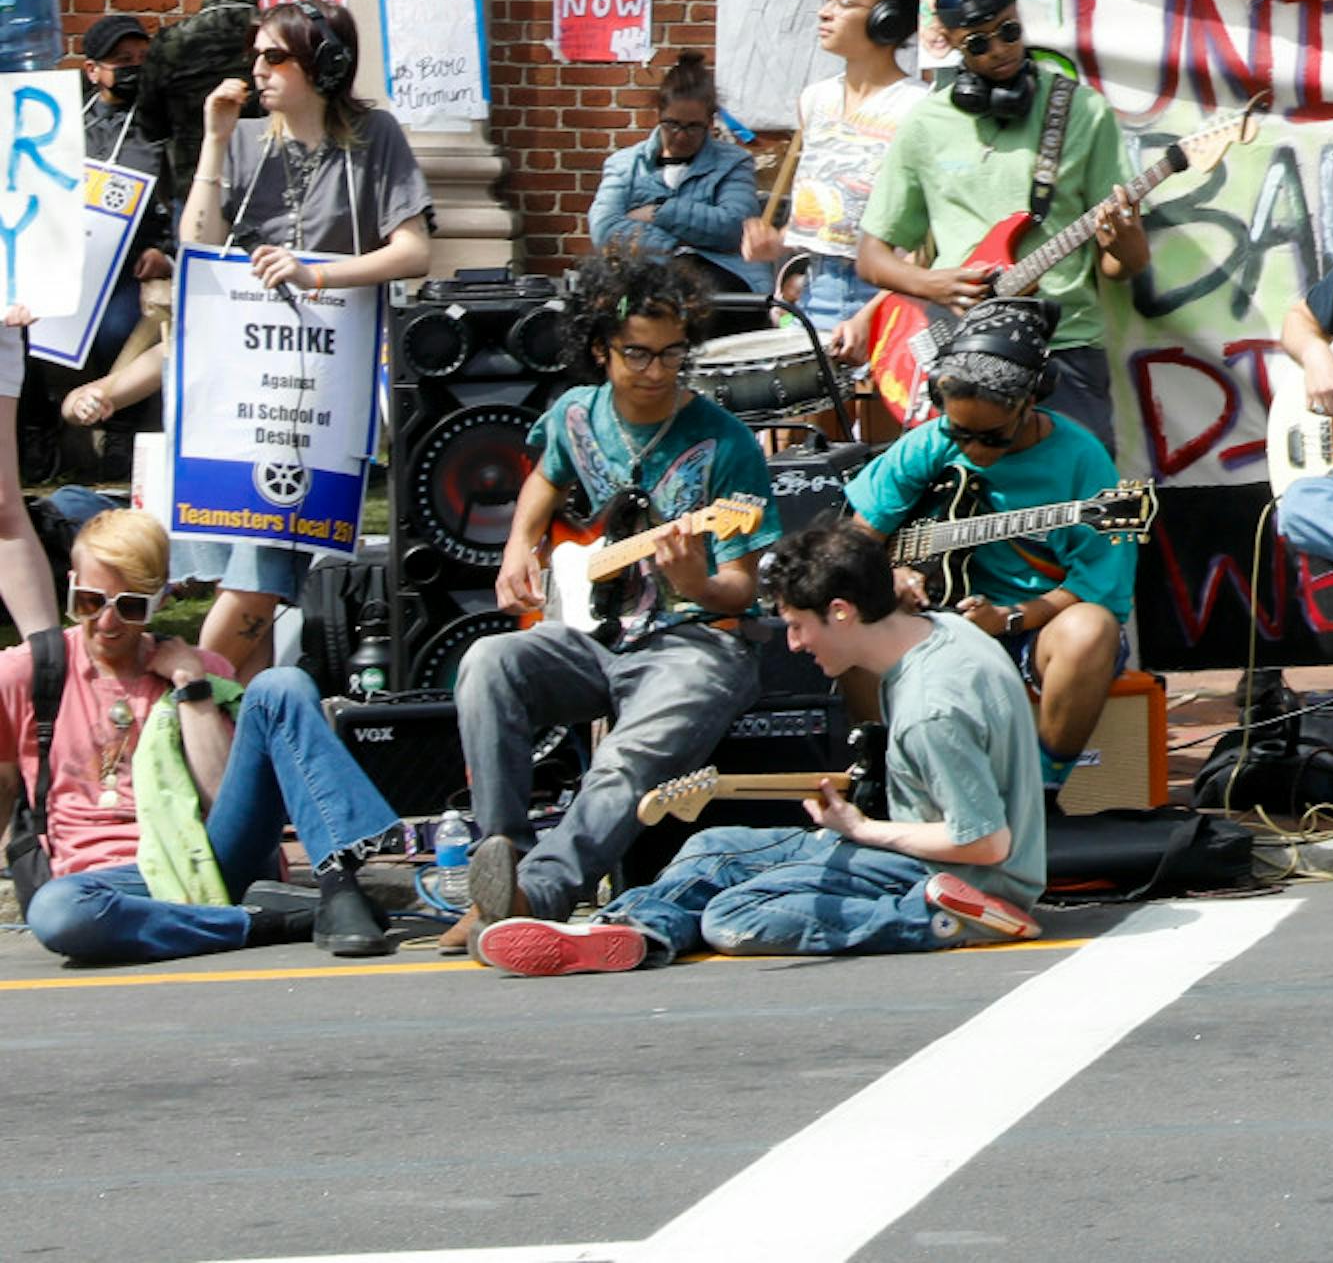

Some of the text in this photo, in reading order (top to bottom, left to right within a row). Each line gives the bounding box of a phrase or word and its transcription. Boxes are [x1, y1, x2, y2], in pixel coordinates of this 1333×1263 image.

[244, 323, 336, 356] STRIKE
[261, 372, 316, 391] Against
[237, 402, 331, 427] RI School of
[255, 427, 311, 450] Design
[177, 502, 284, 531] Teamsters
[289, 513, 328, 538] Local
[354, 725, 395, 743] VOX
